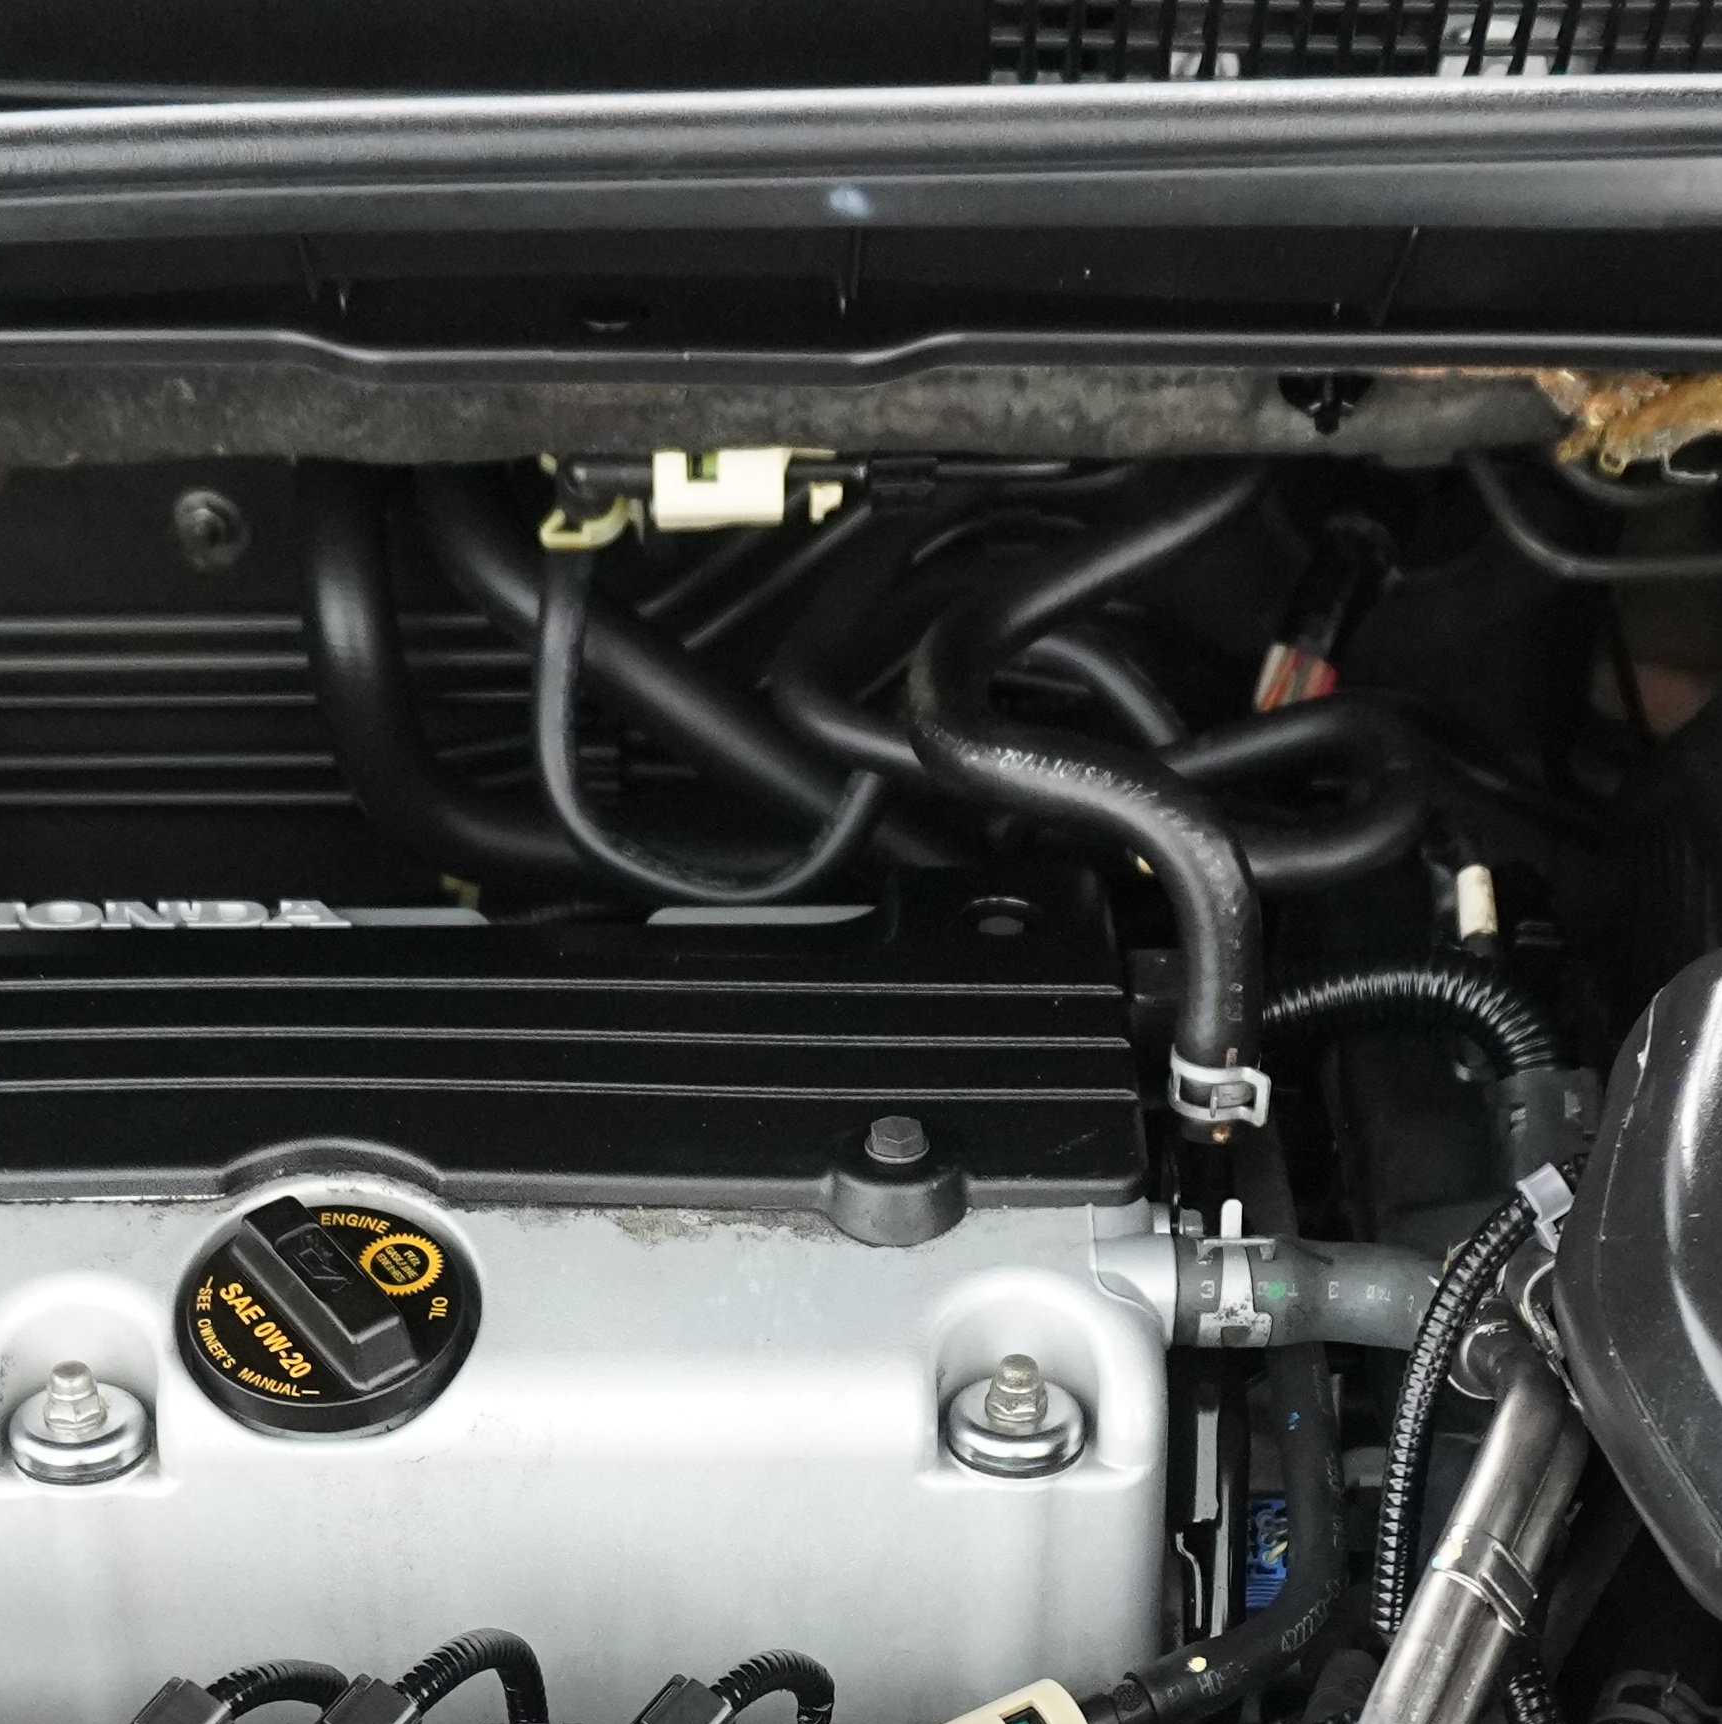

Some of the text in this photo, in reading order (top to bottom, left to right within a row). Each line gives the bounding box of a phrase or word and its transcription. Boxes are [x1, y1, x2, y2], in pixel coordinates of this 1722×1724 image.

[320, 1212, 448, 1320] ENGINE OIL
[197, 1318, 236, 1370] OWNER'S
[220, 1282, 312, 1379] SAE 0W-20
